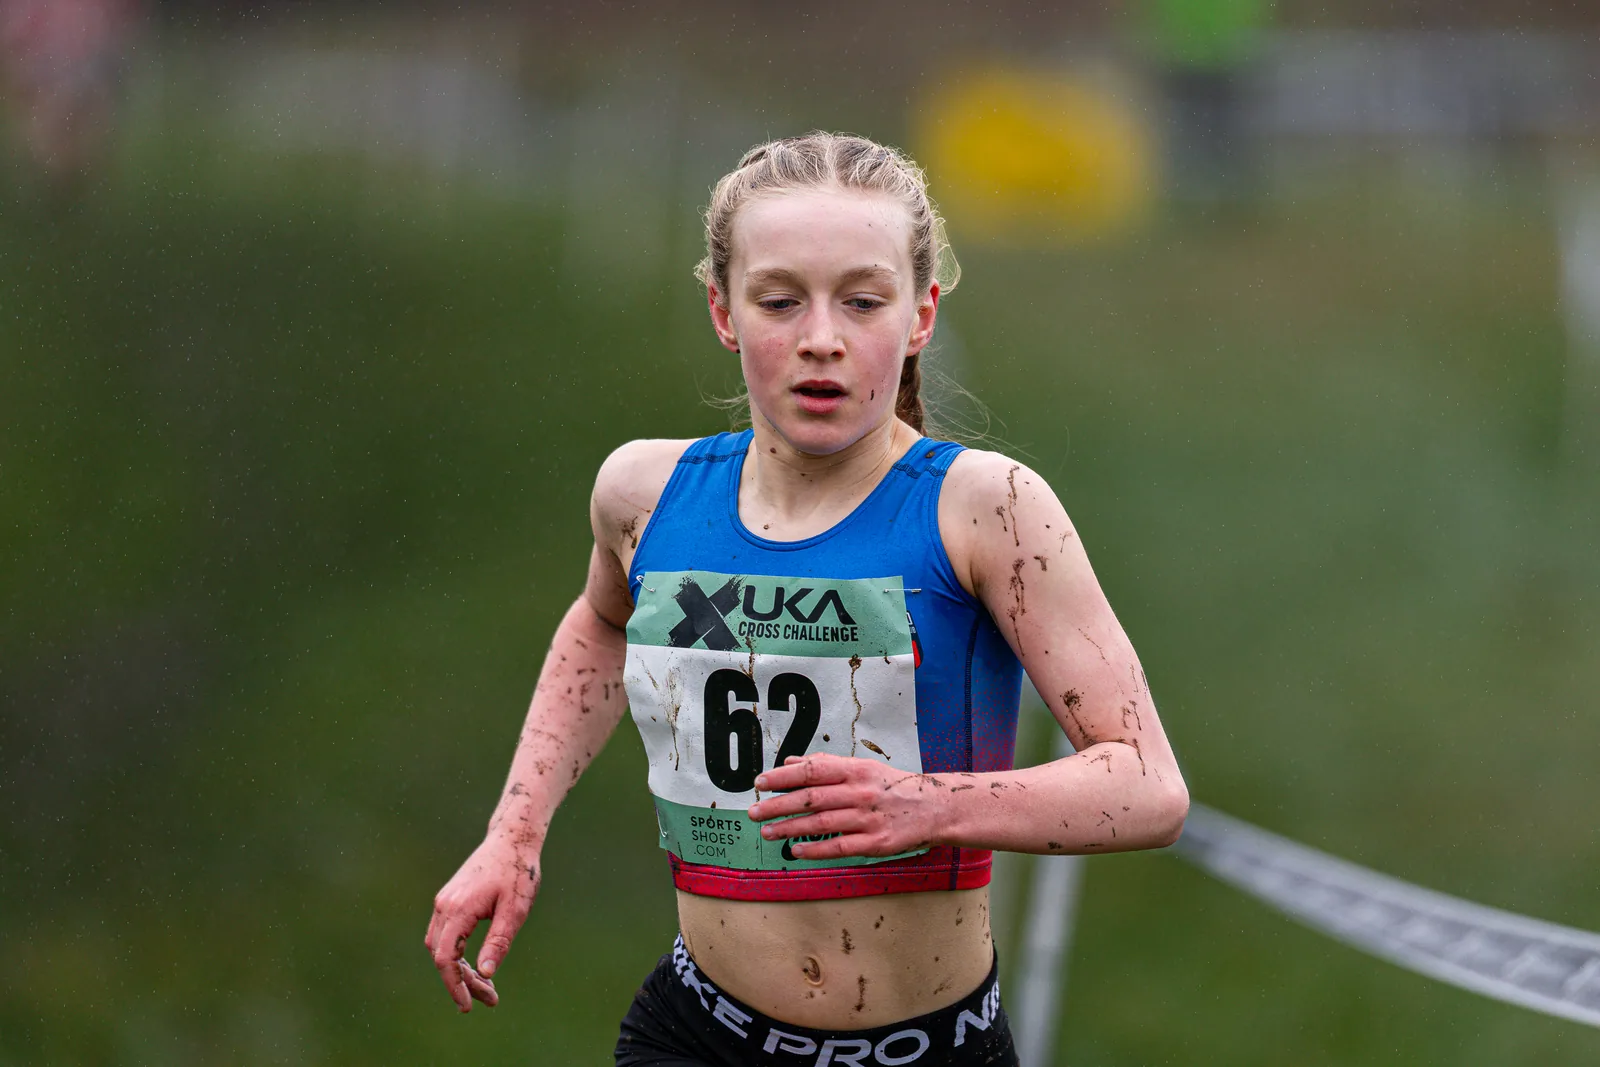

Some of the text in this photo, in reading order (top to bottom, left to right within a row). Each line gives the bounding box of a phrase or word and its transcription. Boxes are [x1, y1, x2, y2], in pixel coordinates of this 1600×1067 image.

[741, 585, 857, 625] UKA
[738, 621, 859, 642] CROSS CHALLENGE
[704, 668, 821, 793] 62
[690, 815, 742, 831] SPORTS
[691, 829, 735, 845] SHOES
[693, 844, 726, 858] .COM
[762, 1027, 930, 1067] PRO
